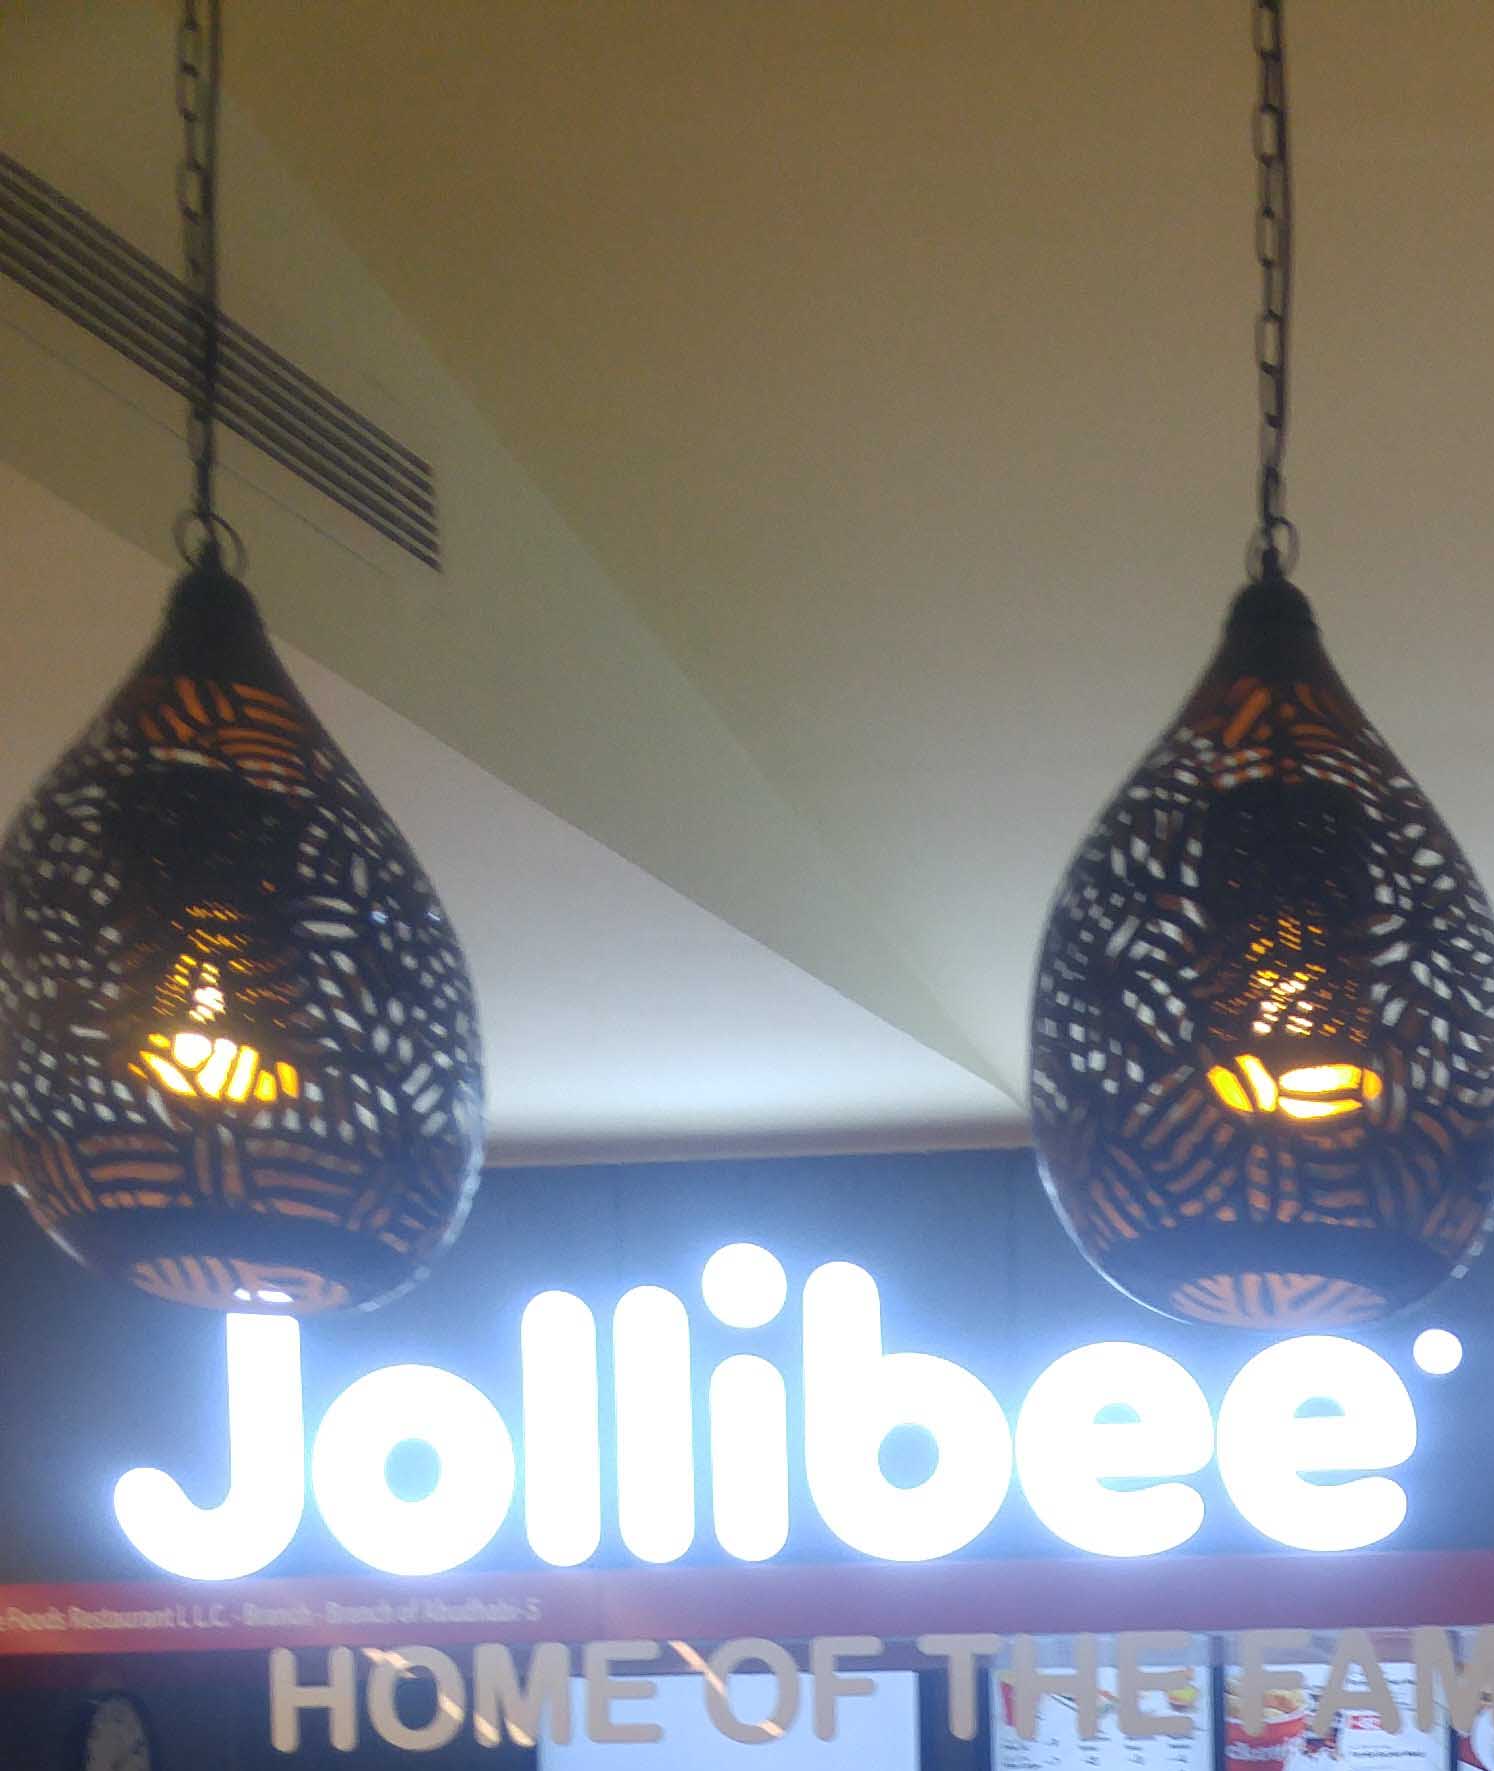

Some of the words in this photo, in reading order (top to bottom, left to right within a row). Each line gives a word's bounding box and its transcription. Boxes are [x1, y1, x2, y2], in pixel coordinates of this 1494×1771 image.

[112, 1242, 1419, 1582] Jollibee
[269, 1641, 663, 1752] HOME
[704, 1635, 885, 1745] OF
[916, 1628, 1195, 1741] THE
